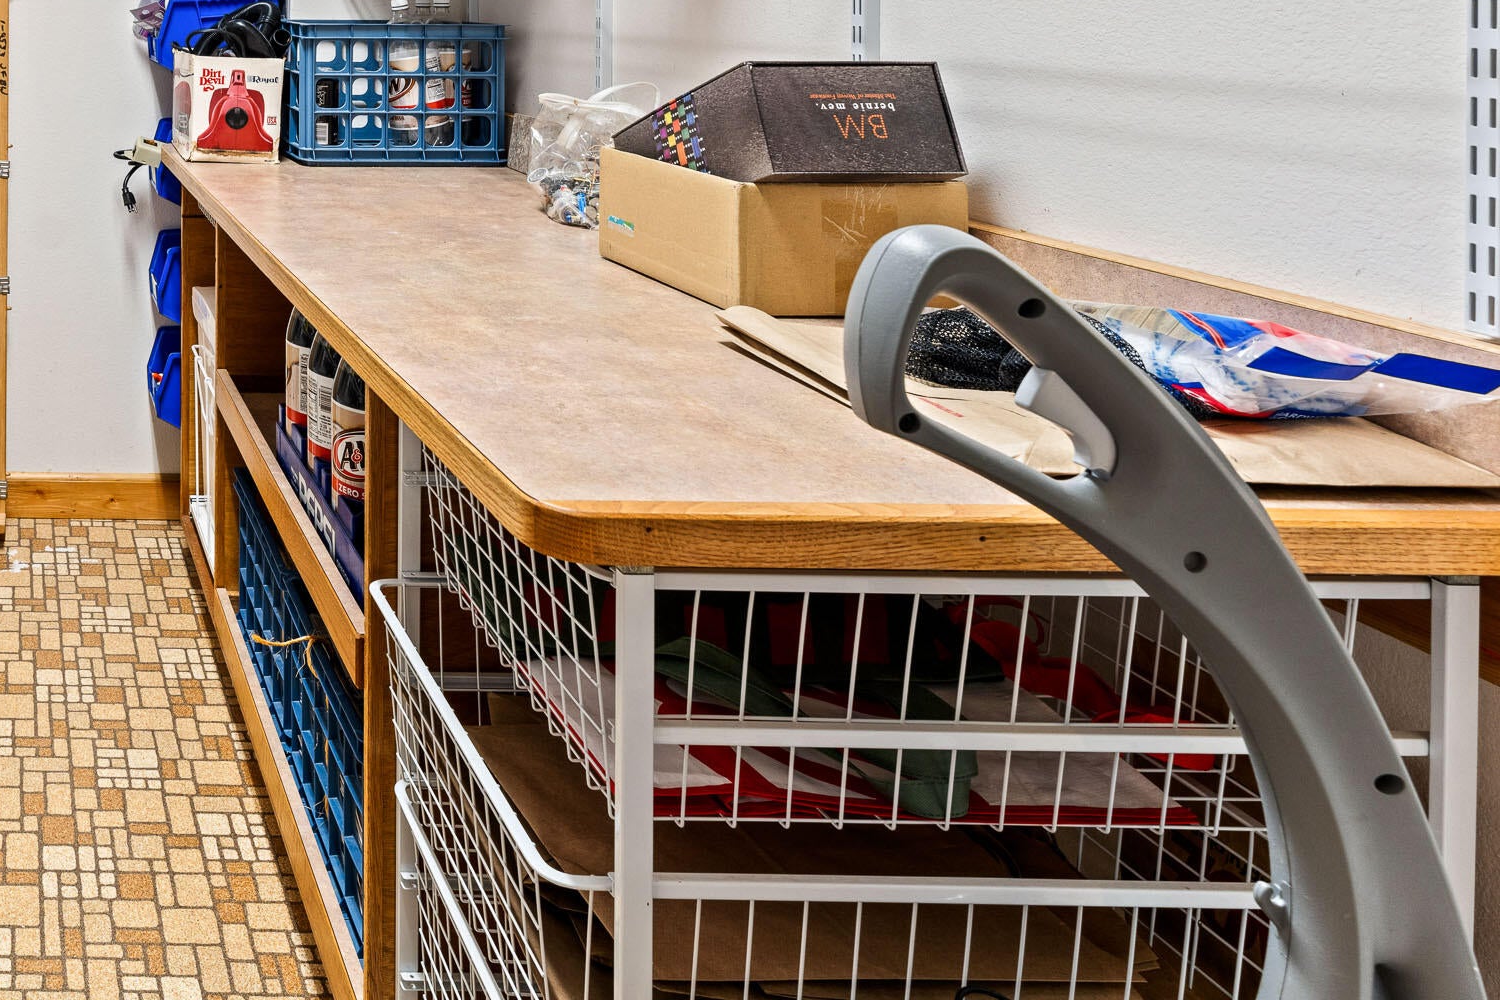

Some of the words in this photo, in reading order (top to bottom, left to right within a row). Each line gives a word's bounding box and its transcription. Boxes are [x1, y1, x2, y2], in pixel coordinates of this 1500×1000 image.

[202, 68, 221, 78] Dirt
[200, 76, 225, 86] Devil
[815, 102, 846, 110] mev.
[852, 102, 896, 112] bernie
[832, 114, 889, 139] BM
[338, 483, 359, 499] ZERO
